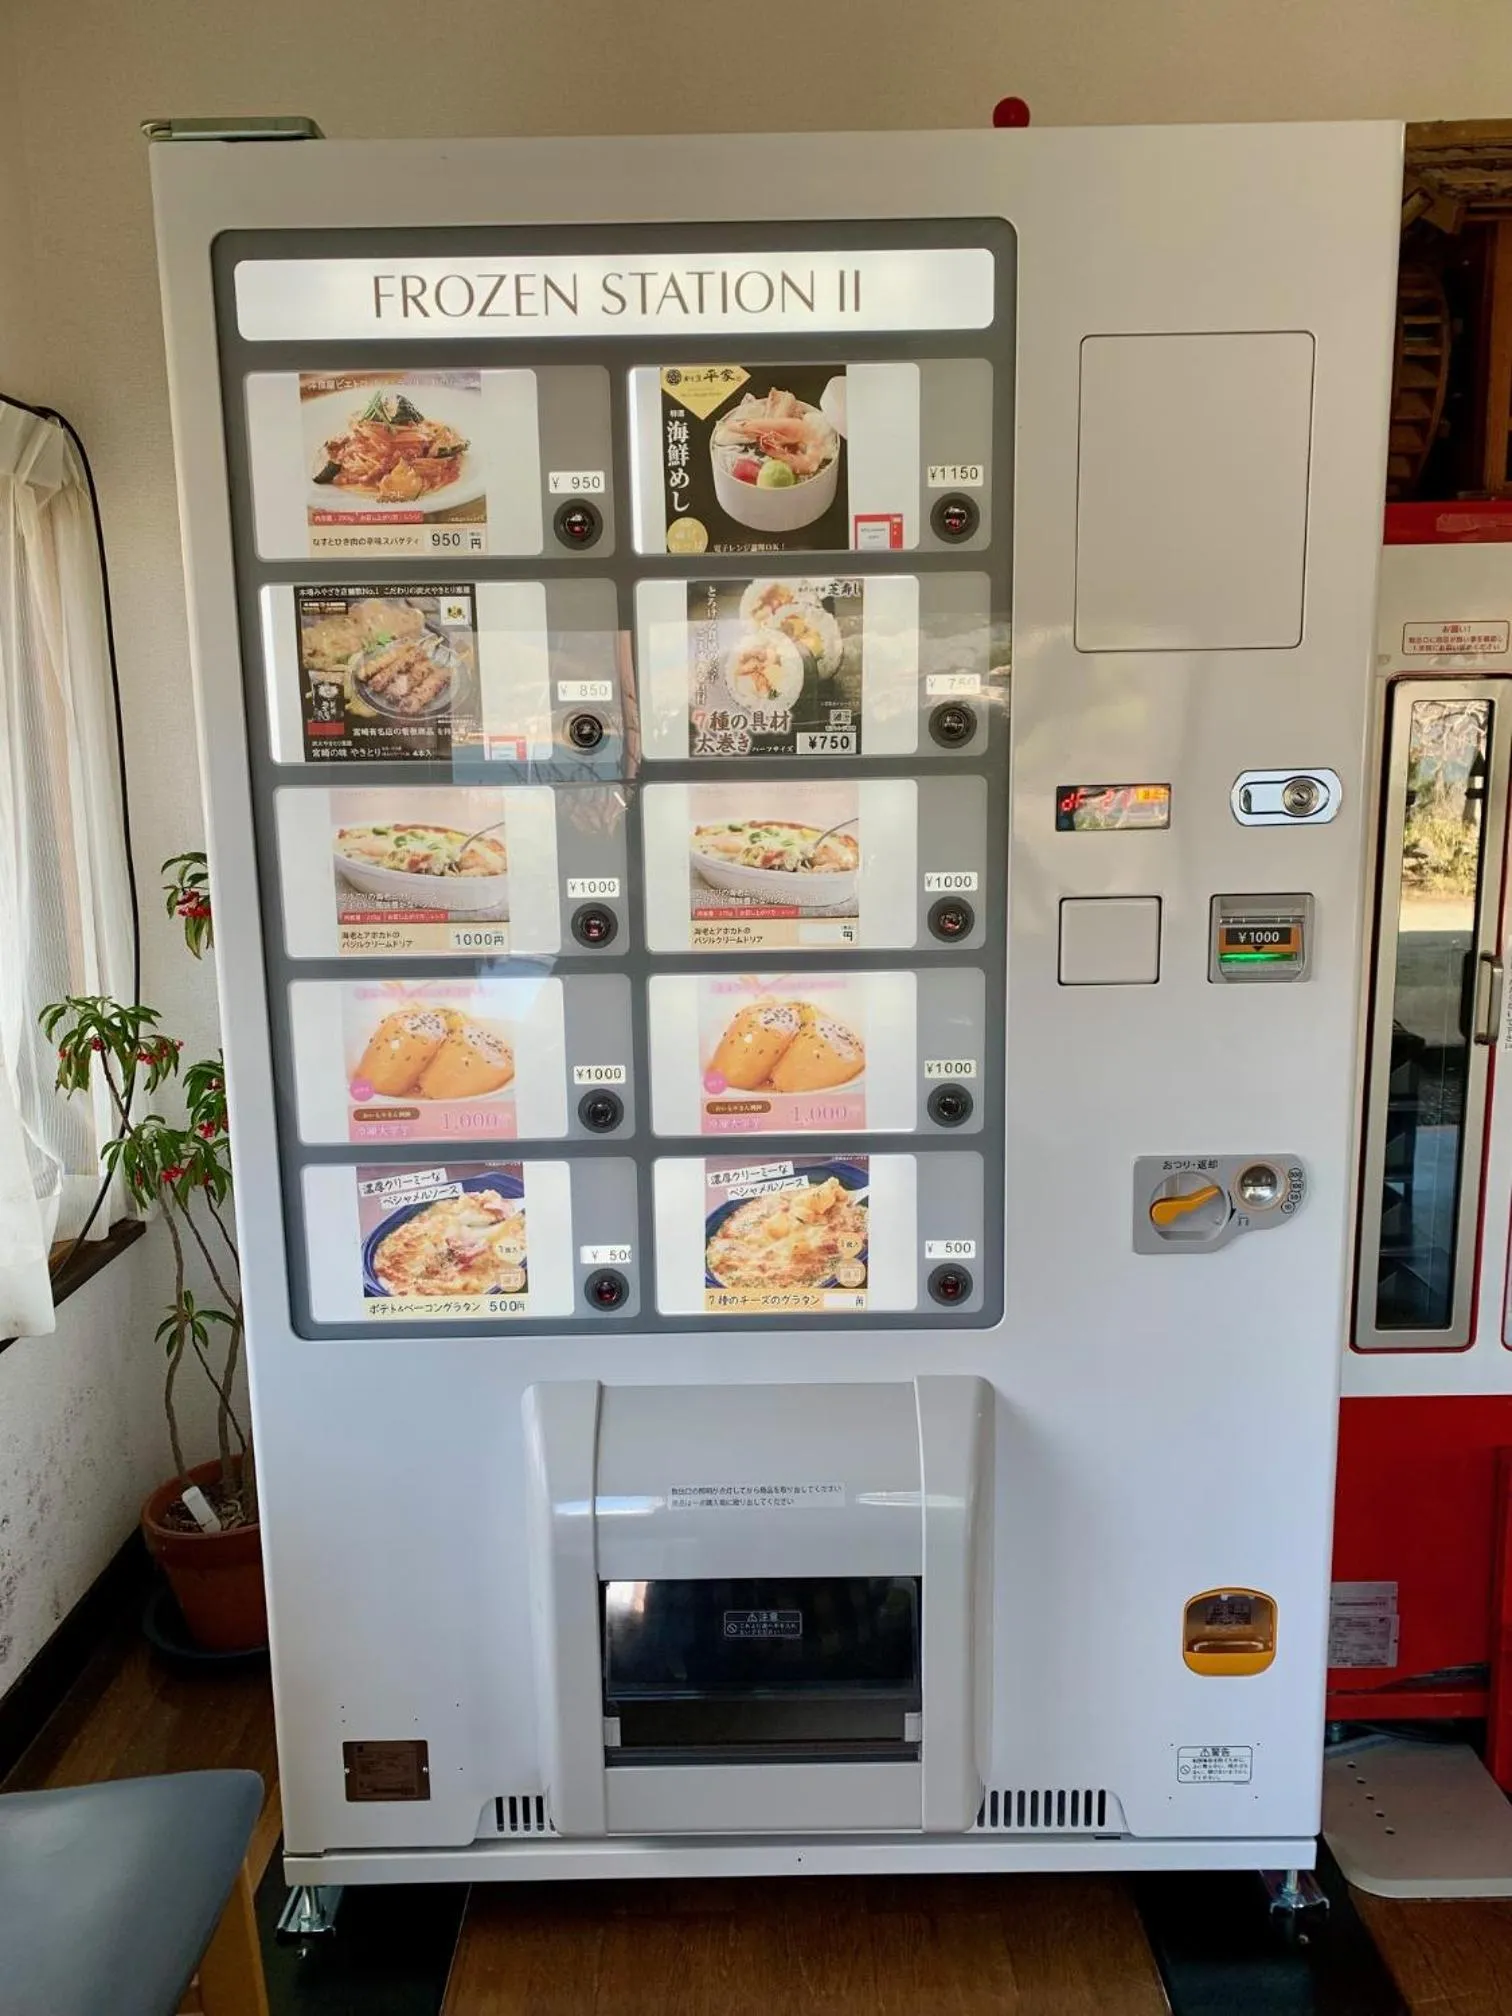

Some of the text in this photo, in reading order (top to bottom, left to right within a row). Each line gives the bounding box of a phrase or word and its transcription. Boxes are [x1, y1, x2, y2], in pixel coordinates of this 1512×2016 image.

[373, 270, 862, 318] FROZEN STATION II
[667, 421, 690, 512] 海鮮めし
[930, 467, 978, 480] ¥1150
[552, 475, 601, 490] ¥ 950
[432, 533, 482, 550] 950 円
[929, 677, 936, 688] ¥
[560, 685, 608, 697] ¥ 850
[692, 709, 791, 732] 7種の具材
[696, 732, 750, 754] 太巻き
[808, 735, 850, 750] ¥750
[312, 748, 347, 758] 宮崎の味
[351, 748, 381, 757] やきとり
[570, 881, 617, 893] ¥1000
[927, 875, 972, 888] ¥1000
[1238, 930, 1280, 943] ¥1000
[576, 1068, 622, 1080] ¥1000
[926, 1063, 972, 1074] ¥1000
[1163, 1160, 1218, 1170] おつり・返却
[711, 1165, 788, 1185] 濃厚クリーミーな
[362, 1172, 441, 1194] 濃厚クリーミーな
[730, 1178, 805, 1197] ベシャメルソース
[383, 1187, 459, 1206] ベシャメルソース
[928, 1242, 972, 1253] ¥ 500
[592, 1250, 598, 1260] ¥
[708, 1295, 820, 1305] 7種のチーズのグラタン
